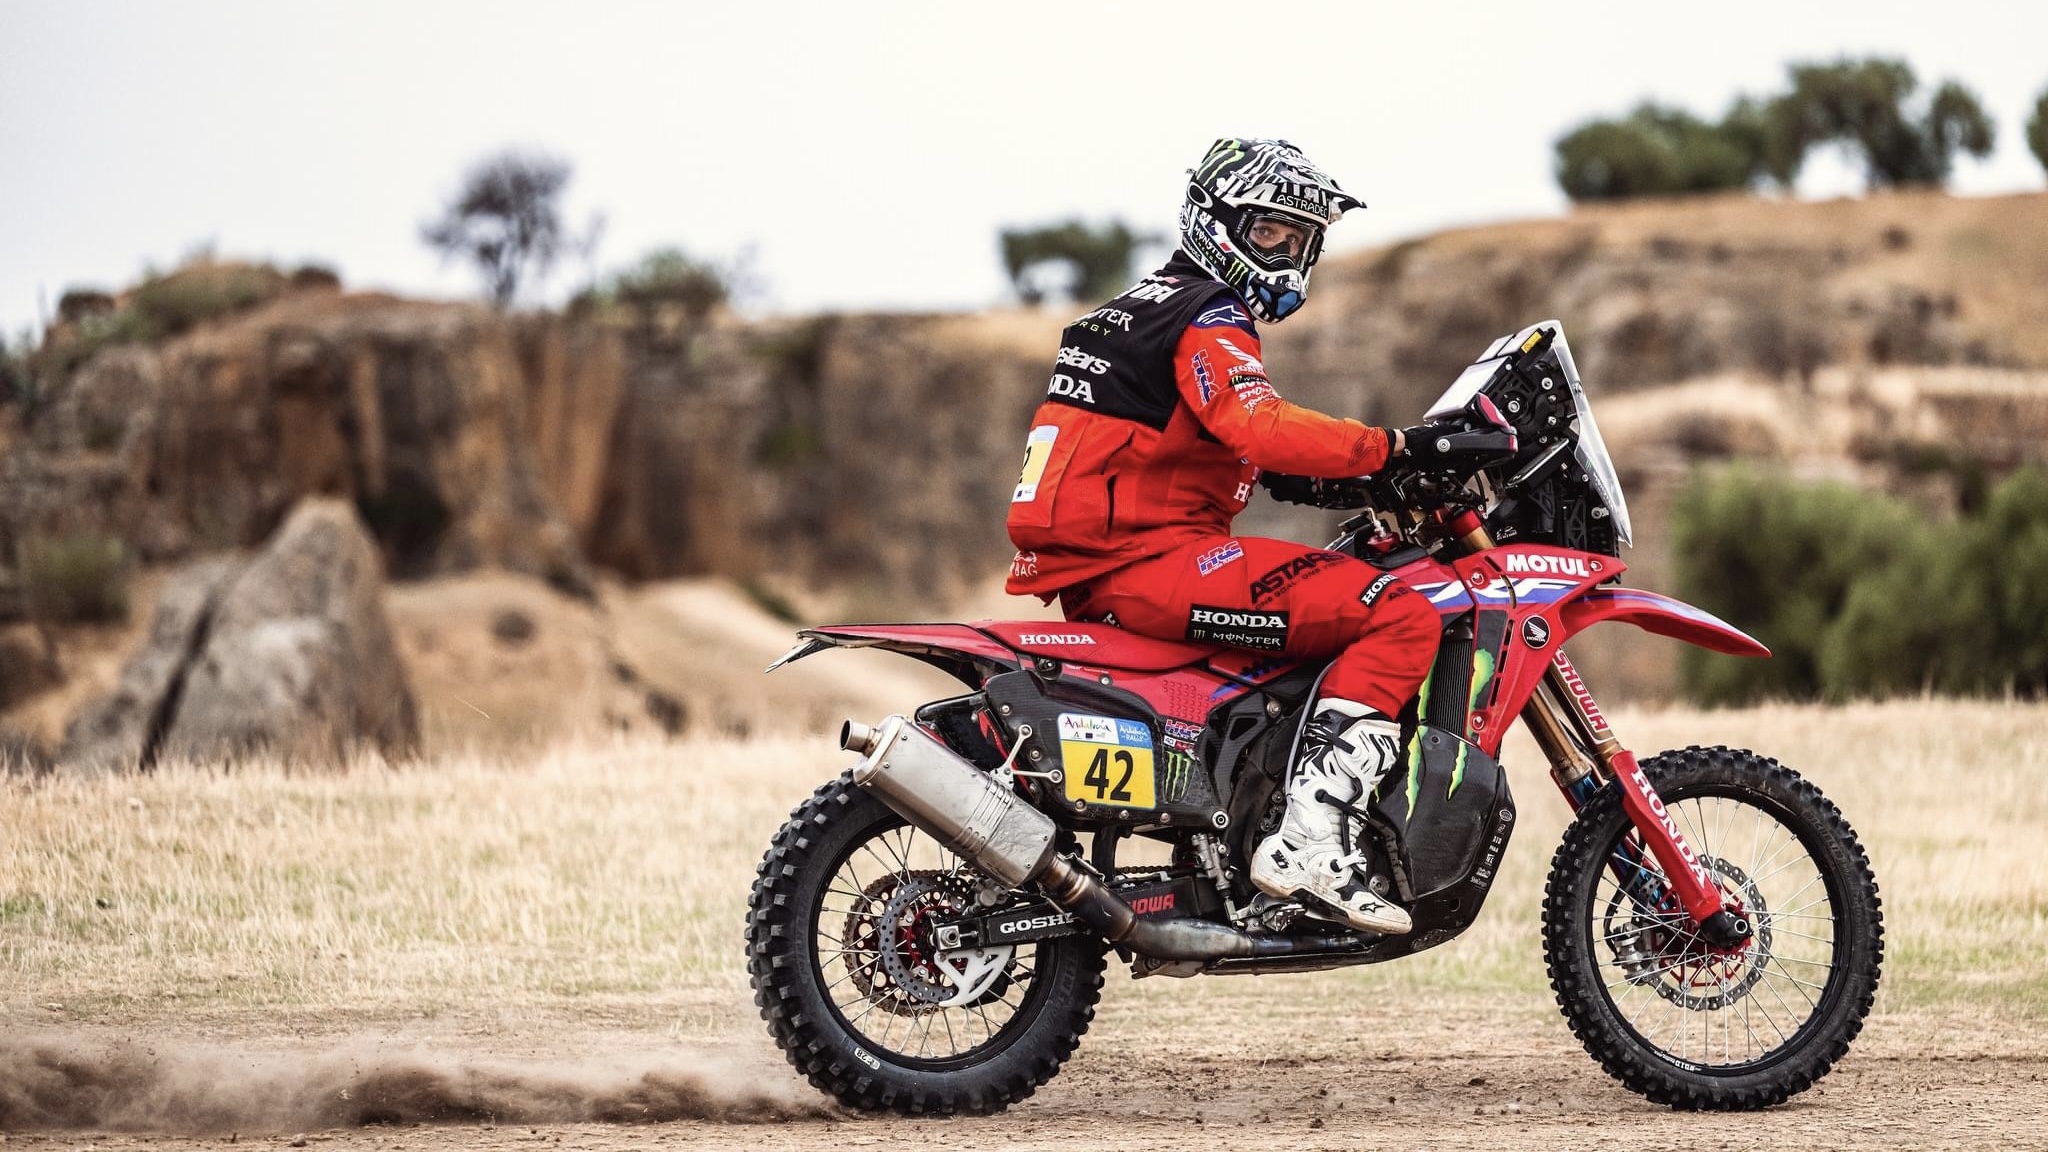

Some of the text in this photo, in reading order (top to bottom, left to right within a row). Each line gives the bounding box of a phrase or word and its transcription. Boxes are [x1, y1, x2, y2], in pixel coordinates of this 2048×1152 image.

[1194, 224, 1228, 266] MONSTER
[1071, 321, 1112, 336] RGY
[1056, 345, 1112, 375] stars
[1197, 541, 1243, 575] HRC
[1507, 554, 1590, 578] MOTUL
[1191, 609, 1288, 629] HONDA
[1019, 634, 1097, 645] HONDA
[1212, 632, 1282, 646] MONSTER
[1553, 649, 1609, 732] SHOWA
[1084, 748, 1134, 802] 42
[1631, 769, 1706, 889] HONDA
